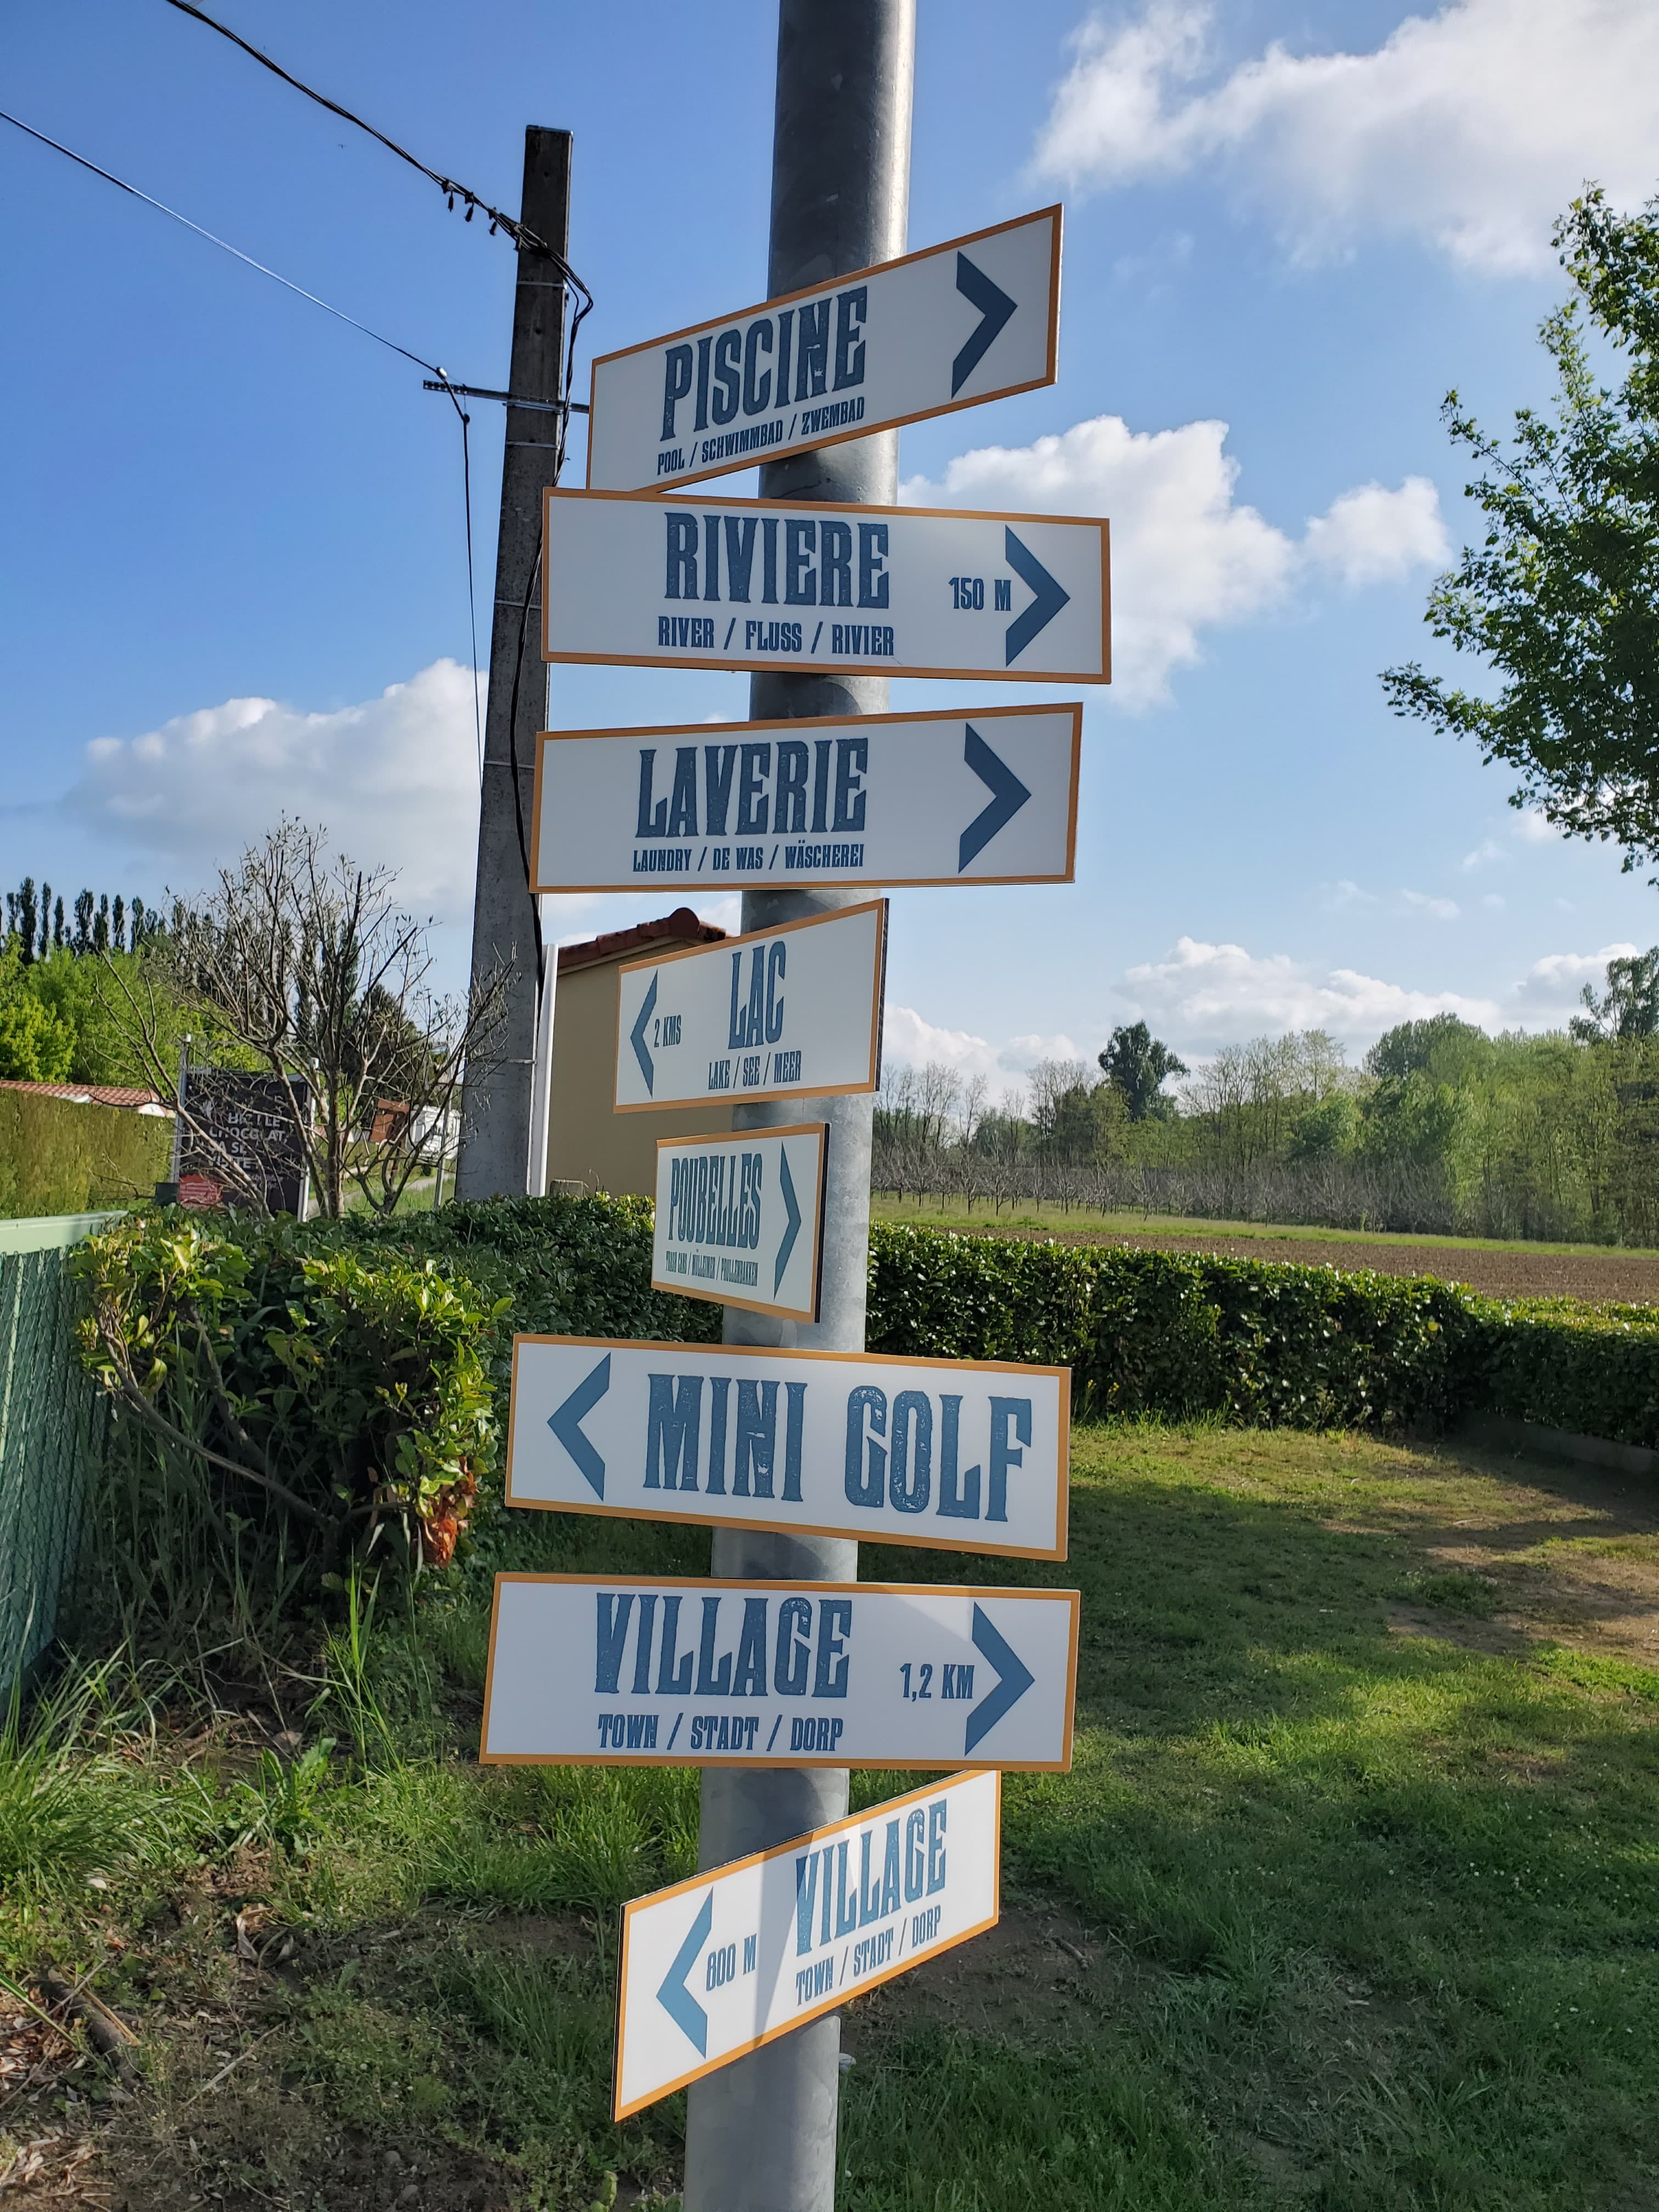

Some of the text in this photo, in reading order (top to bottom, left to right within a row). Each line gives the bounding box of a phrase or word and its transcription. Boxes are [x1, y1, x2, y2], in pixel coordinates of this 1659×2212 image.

[660, 285, 867, 442] PISCINE
[657, 448, 685, 476] POOL
[702, 420, 783, 462] SCHWIMMBAD
[802, 396, 865, 435] ZWEMBAD
[664, 512, 889, 609] RIVIERE
[949, 578, 1011, 611] 150 M
[658, 616, 714, 648] RIVER
[746, 620, 802, 652] FLUSS
[832, 625, 894, 656] RIVIER
[635, 738, 868, 838] LAVERIE
[633, 849, 692, 872] LAUNDRY
[713, 848, 730, 870] DE
[736, 847, 763, 870] WAS
[785, 840, 864, 868] WÄSCHEREI
[654, 1015, 681, 1047] 2 KMS
[728, 941, 786, 1049] LAC
[708, 1060, 730, 1090] LAKE
[743, 1056, 760, 1086] SEE
[774, 1051, 801, 1083] MEER
[669, 1153, 762, 1249] POUBELLES
[643, 1374, 1031, 1522] MINI GOLF
[595, 1593, 851, 1697] VILLAGE
[900, 1663, 974, 1702] 1,2 KM
[598, 1714, 659, 1748] TOWN
[691, 1716, 759, 1750] STADT
[790, 1718, 843, 1751] DORP
[795, 1798, 947, 1957] VILLAGE
[706, 1934, 757, 1991] 800 M
[795, 1956, 834, 2006] TOWN
[853, 1929, 894, 1977] STADT
[912, 1905, 940, 1948] DORP
